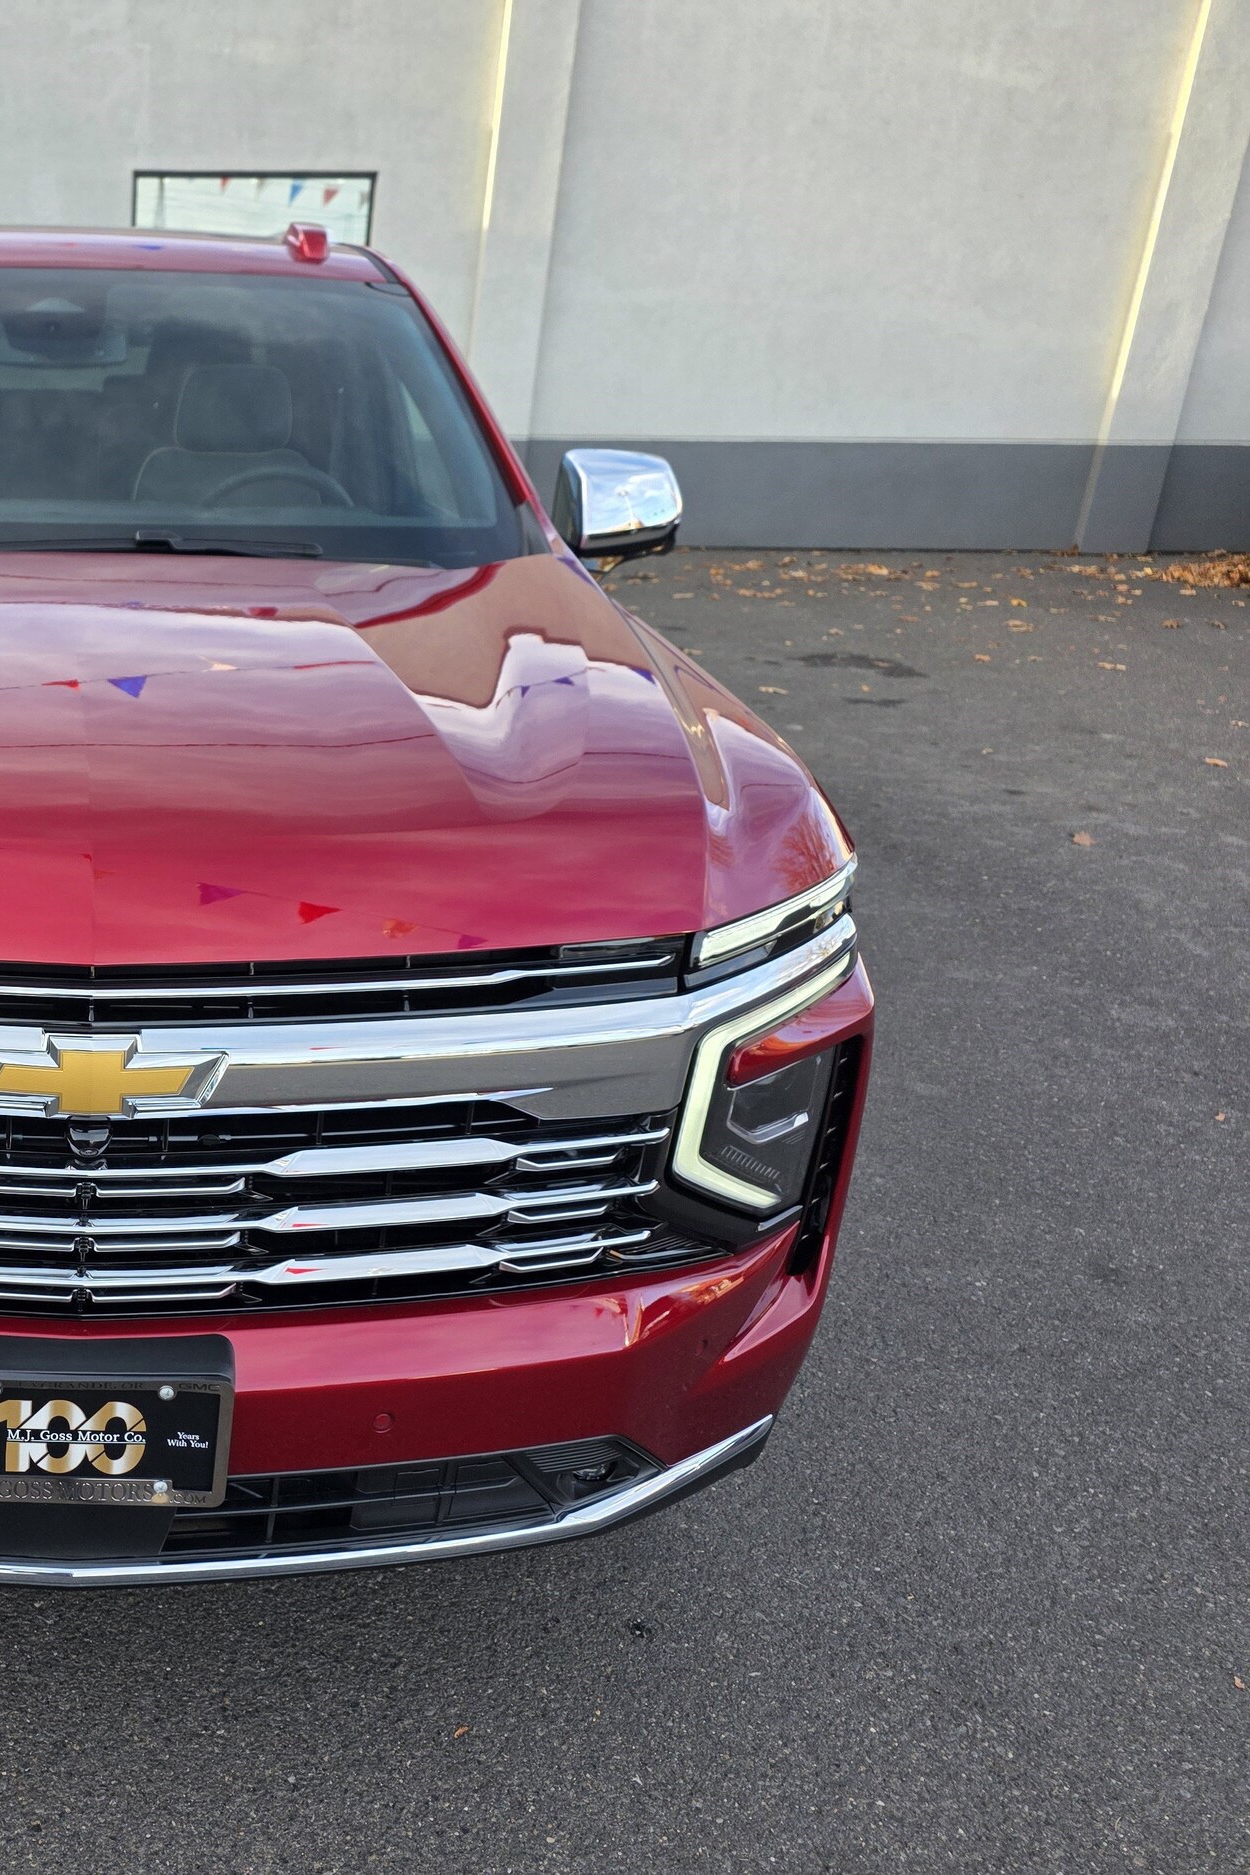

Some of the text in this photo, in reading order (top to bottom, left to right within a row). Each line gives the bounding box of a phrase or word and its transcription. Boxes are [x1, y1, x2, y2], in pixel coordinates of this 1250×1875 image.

[178, 1383, 221, 1392] GMC
[6, 1429, 146, 1443] M.J. Goss Motor Co.
[177, 1431, 200, 1441] Years
[167, 1438, 209, 1449] With You!
